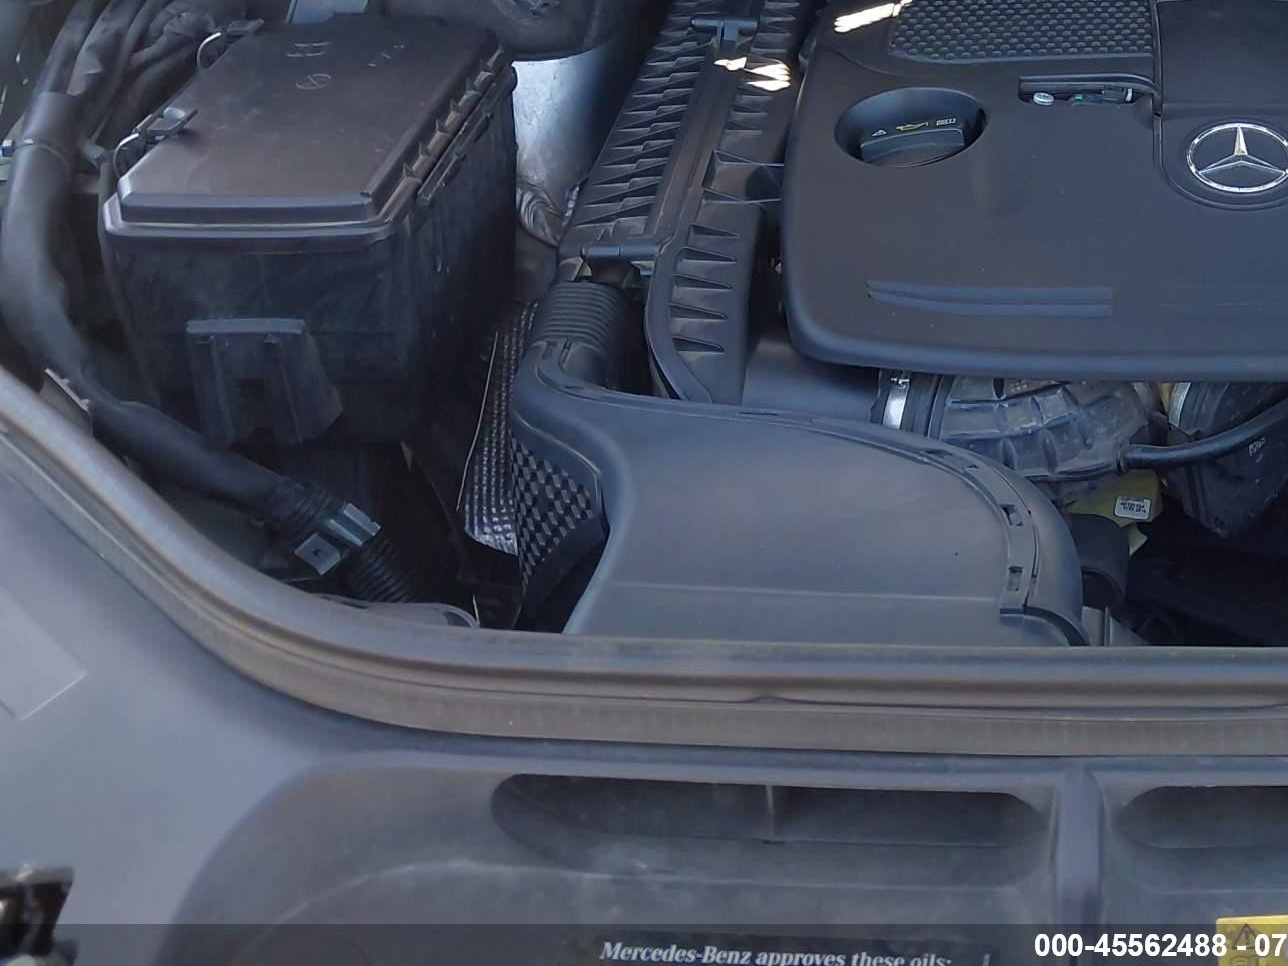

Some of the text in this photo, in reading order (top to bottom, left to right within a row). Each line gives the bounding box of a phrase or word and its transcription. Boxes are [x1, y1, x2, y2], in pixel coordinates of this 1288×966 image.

[600, 941, 753, 965] Mercedes-Benz
[755, 951, 846, 966] approves
[851, 951, 905, 966] these
